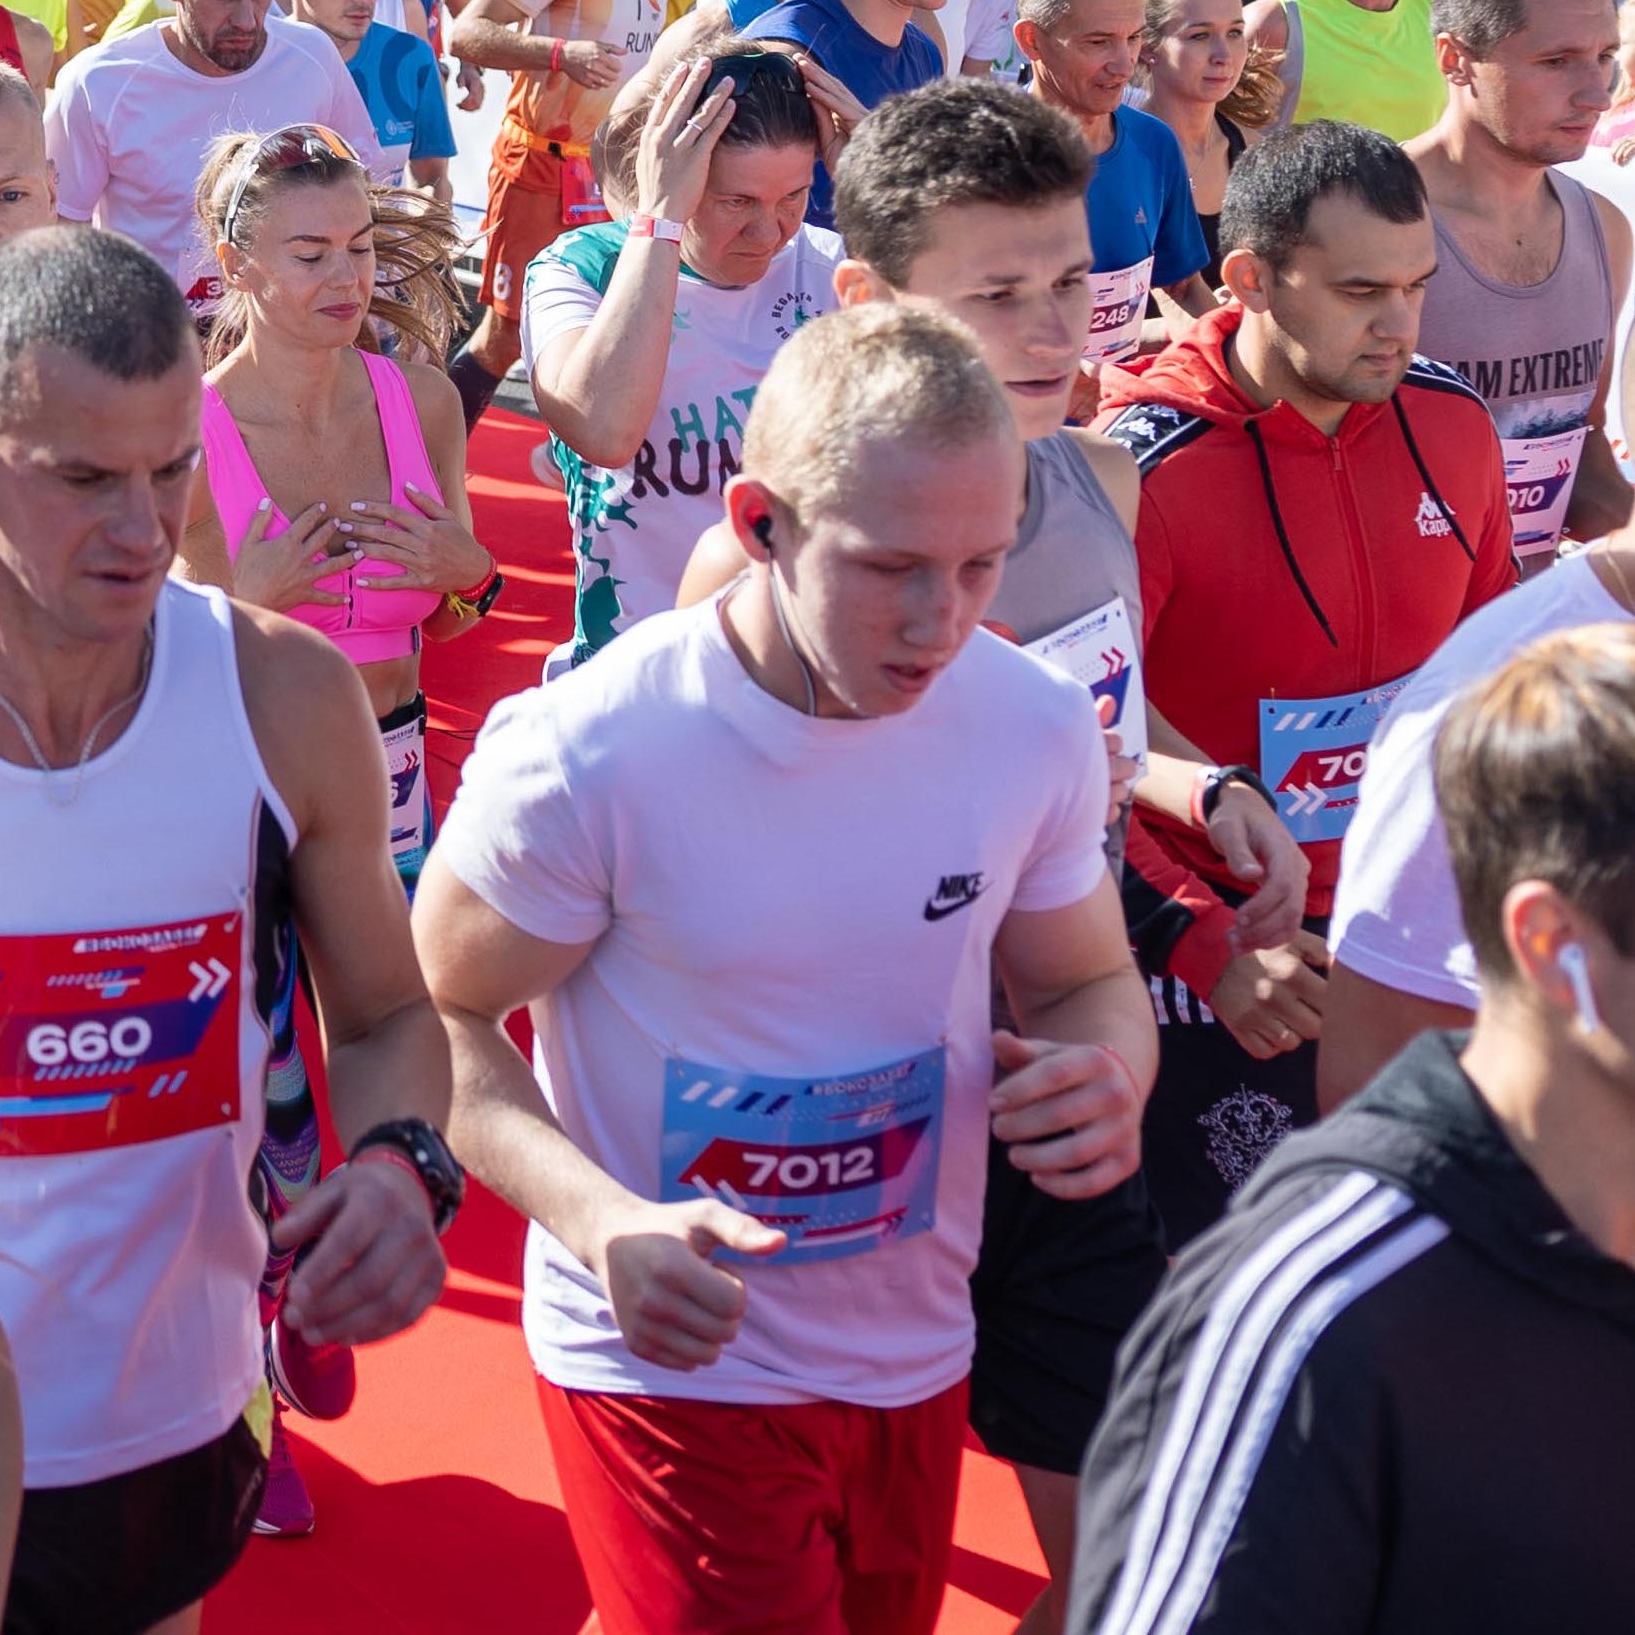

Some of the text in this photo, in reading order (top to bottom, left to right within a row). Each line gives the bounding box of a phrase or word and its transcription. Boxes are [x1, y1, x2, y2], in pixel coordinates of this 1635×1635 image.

[493, 263, 513, 302] 8
[1418, 518, 1453, 537] Kapp
[935, 870, 984, 901] NIKE
[26, 1015, 153, 1066] 660
[742, 1146, 875, 1190] 7012
